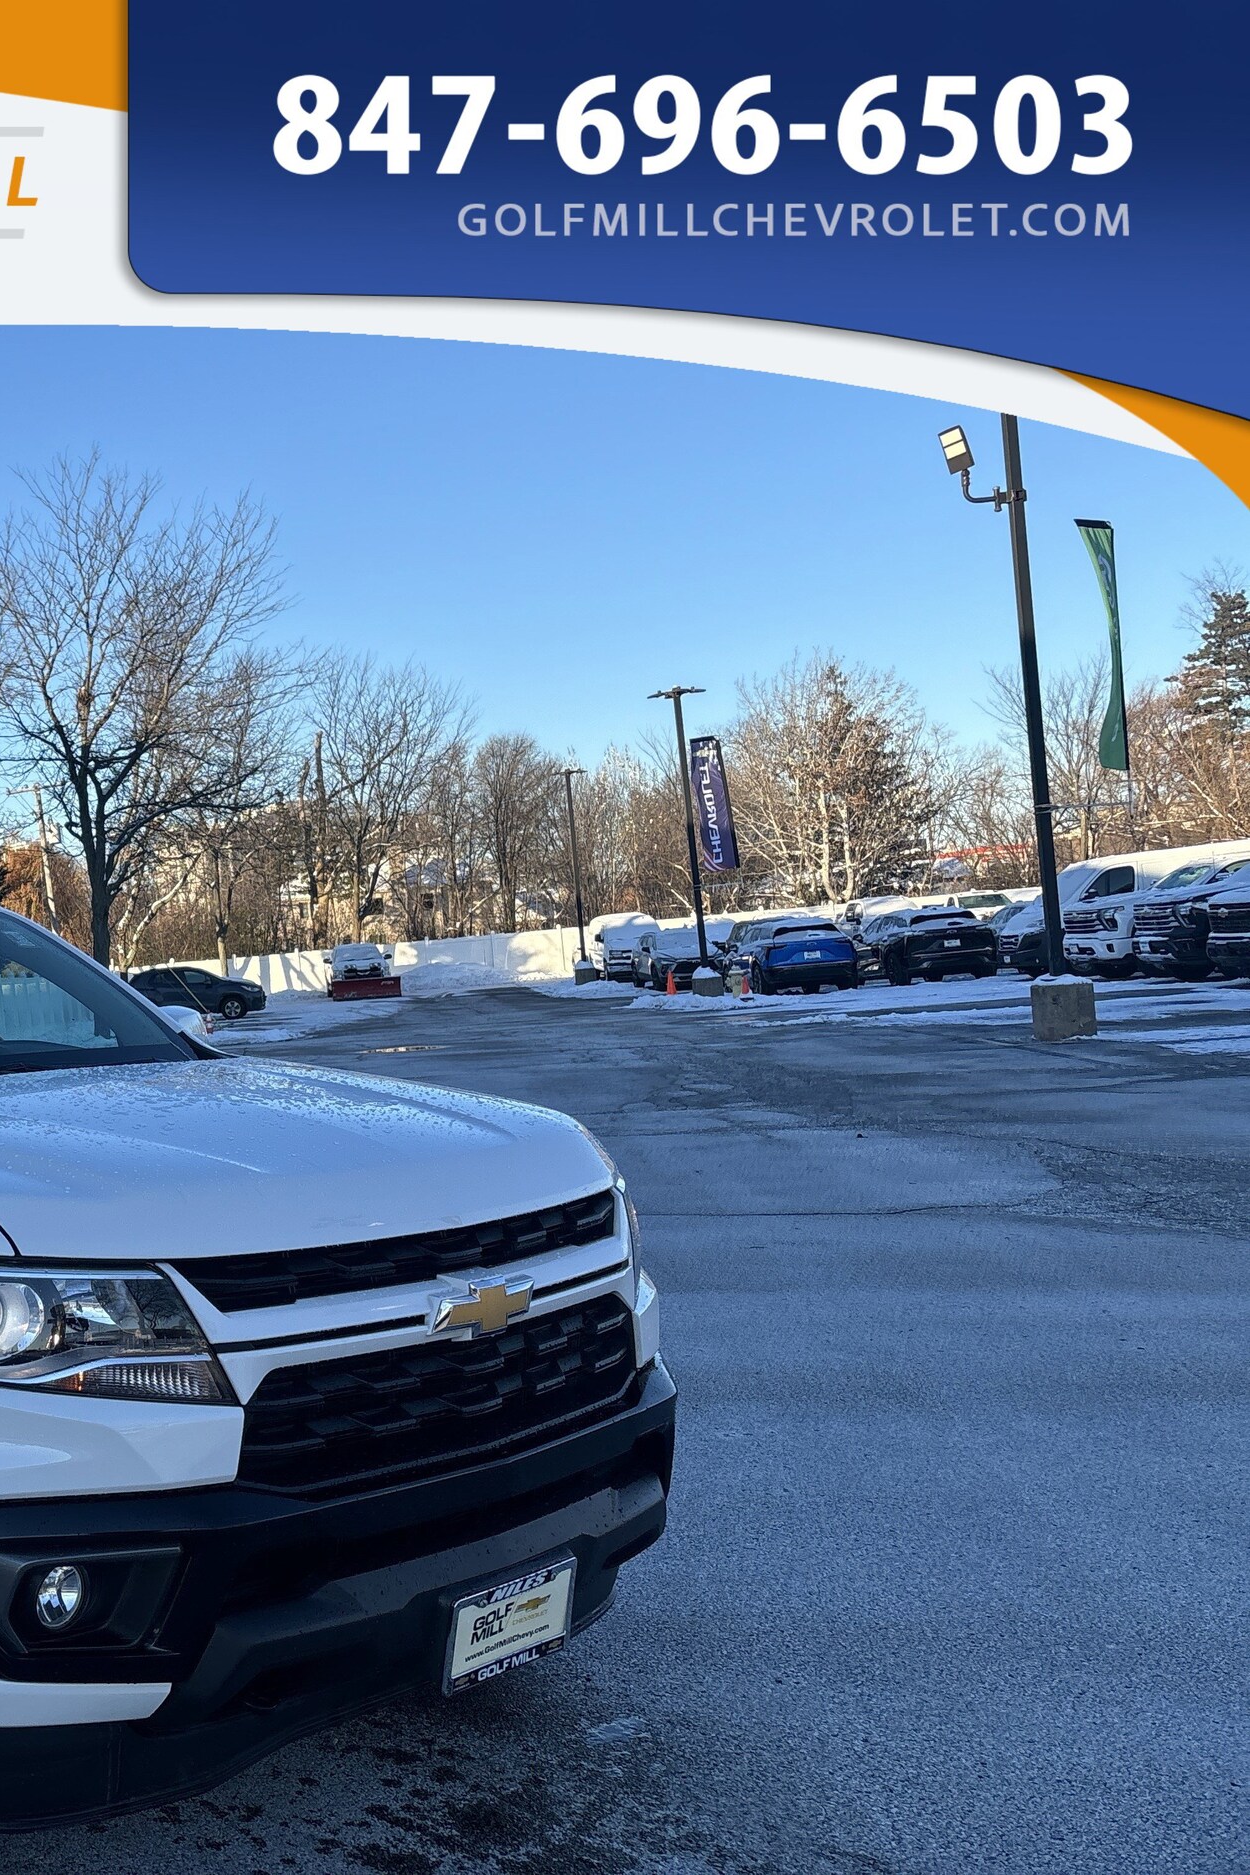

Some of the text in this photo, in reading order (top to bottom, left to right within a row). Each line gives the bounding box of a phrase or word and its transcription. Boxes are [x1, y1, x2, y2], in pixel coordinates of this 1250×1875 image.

[490, 1571, 548, 1603] NILES
[470, 1619, 504, 1646] MILL
[473, 1601, 515, 1632] GOLF
[464, 1624, 550, 1663] www.GolfMillChevy.com
[477, 1648, 540, 1682] GOLF MILL
